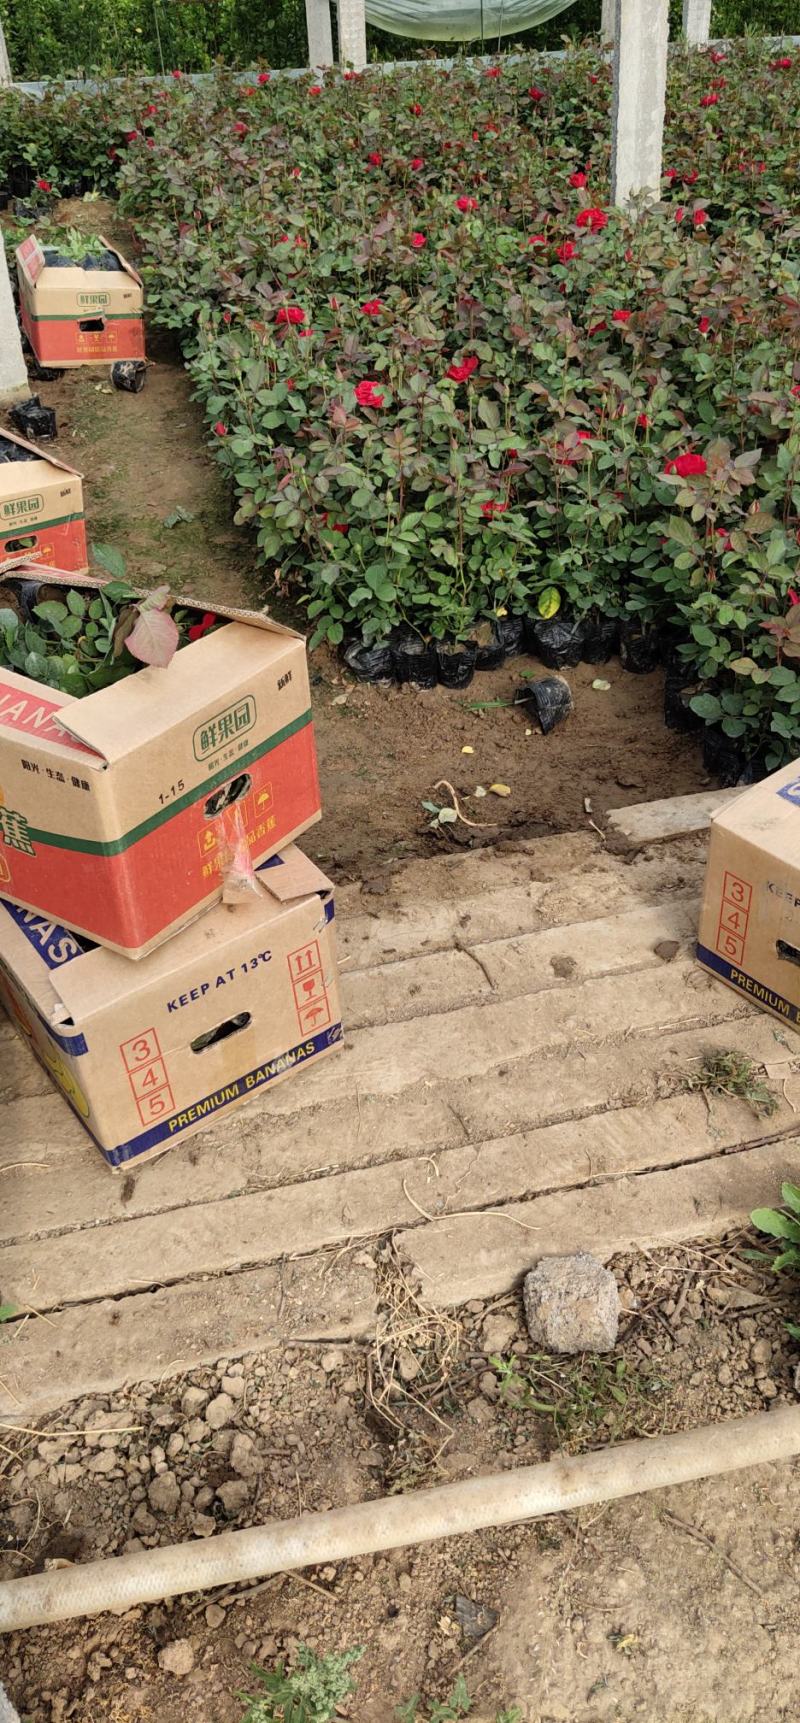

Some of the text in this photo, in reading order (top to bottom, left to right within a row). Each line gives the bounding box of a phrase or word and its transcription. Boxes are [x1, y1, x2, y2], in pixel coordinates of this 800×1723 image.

[3, 497, 40, 516] 鲜果园
[200, 702, 251, 755] 鲜果园
[158, 778, 185, 805] 1-15
[730, 881, 744, 903] 3
[726, 911, 741, 930] 4
[723, 937, 738, 956] 5
[166, 982, 210, 1014] KEEP
[215, 967, 236, 989] AT
[730, 968, 790, 1016] PREMIUM
[131, 1038, 152, 1063] 3
[141, 1066, 160, 1089] 4
[168, 1041, 316, 1133] PREMIUM BANANAS
[149, 1098, 167, 1118] 5
